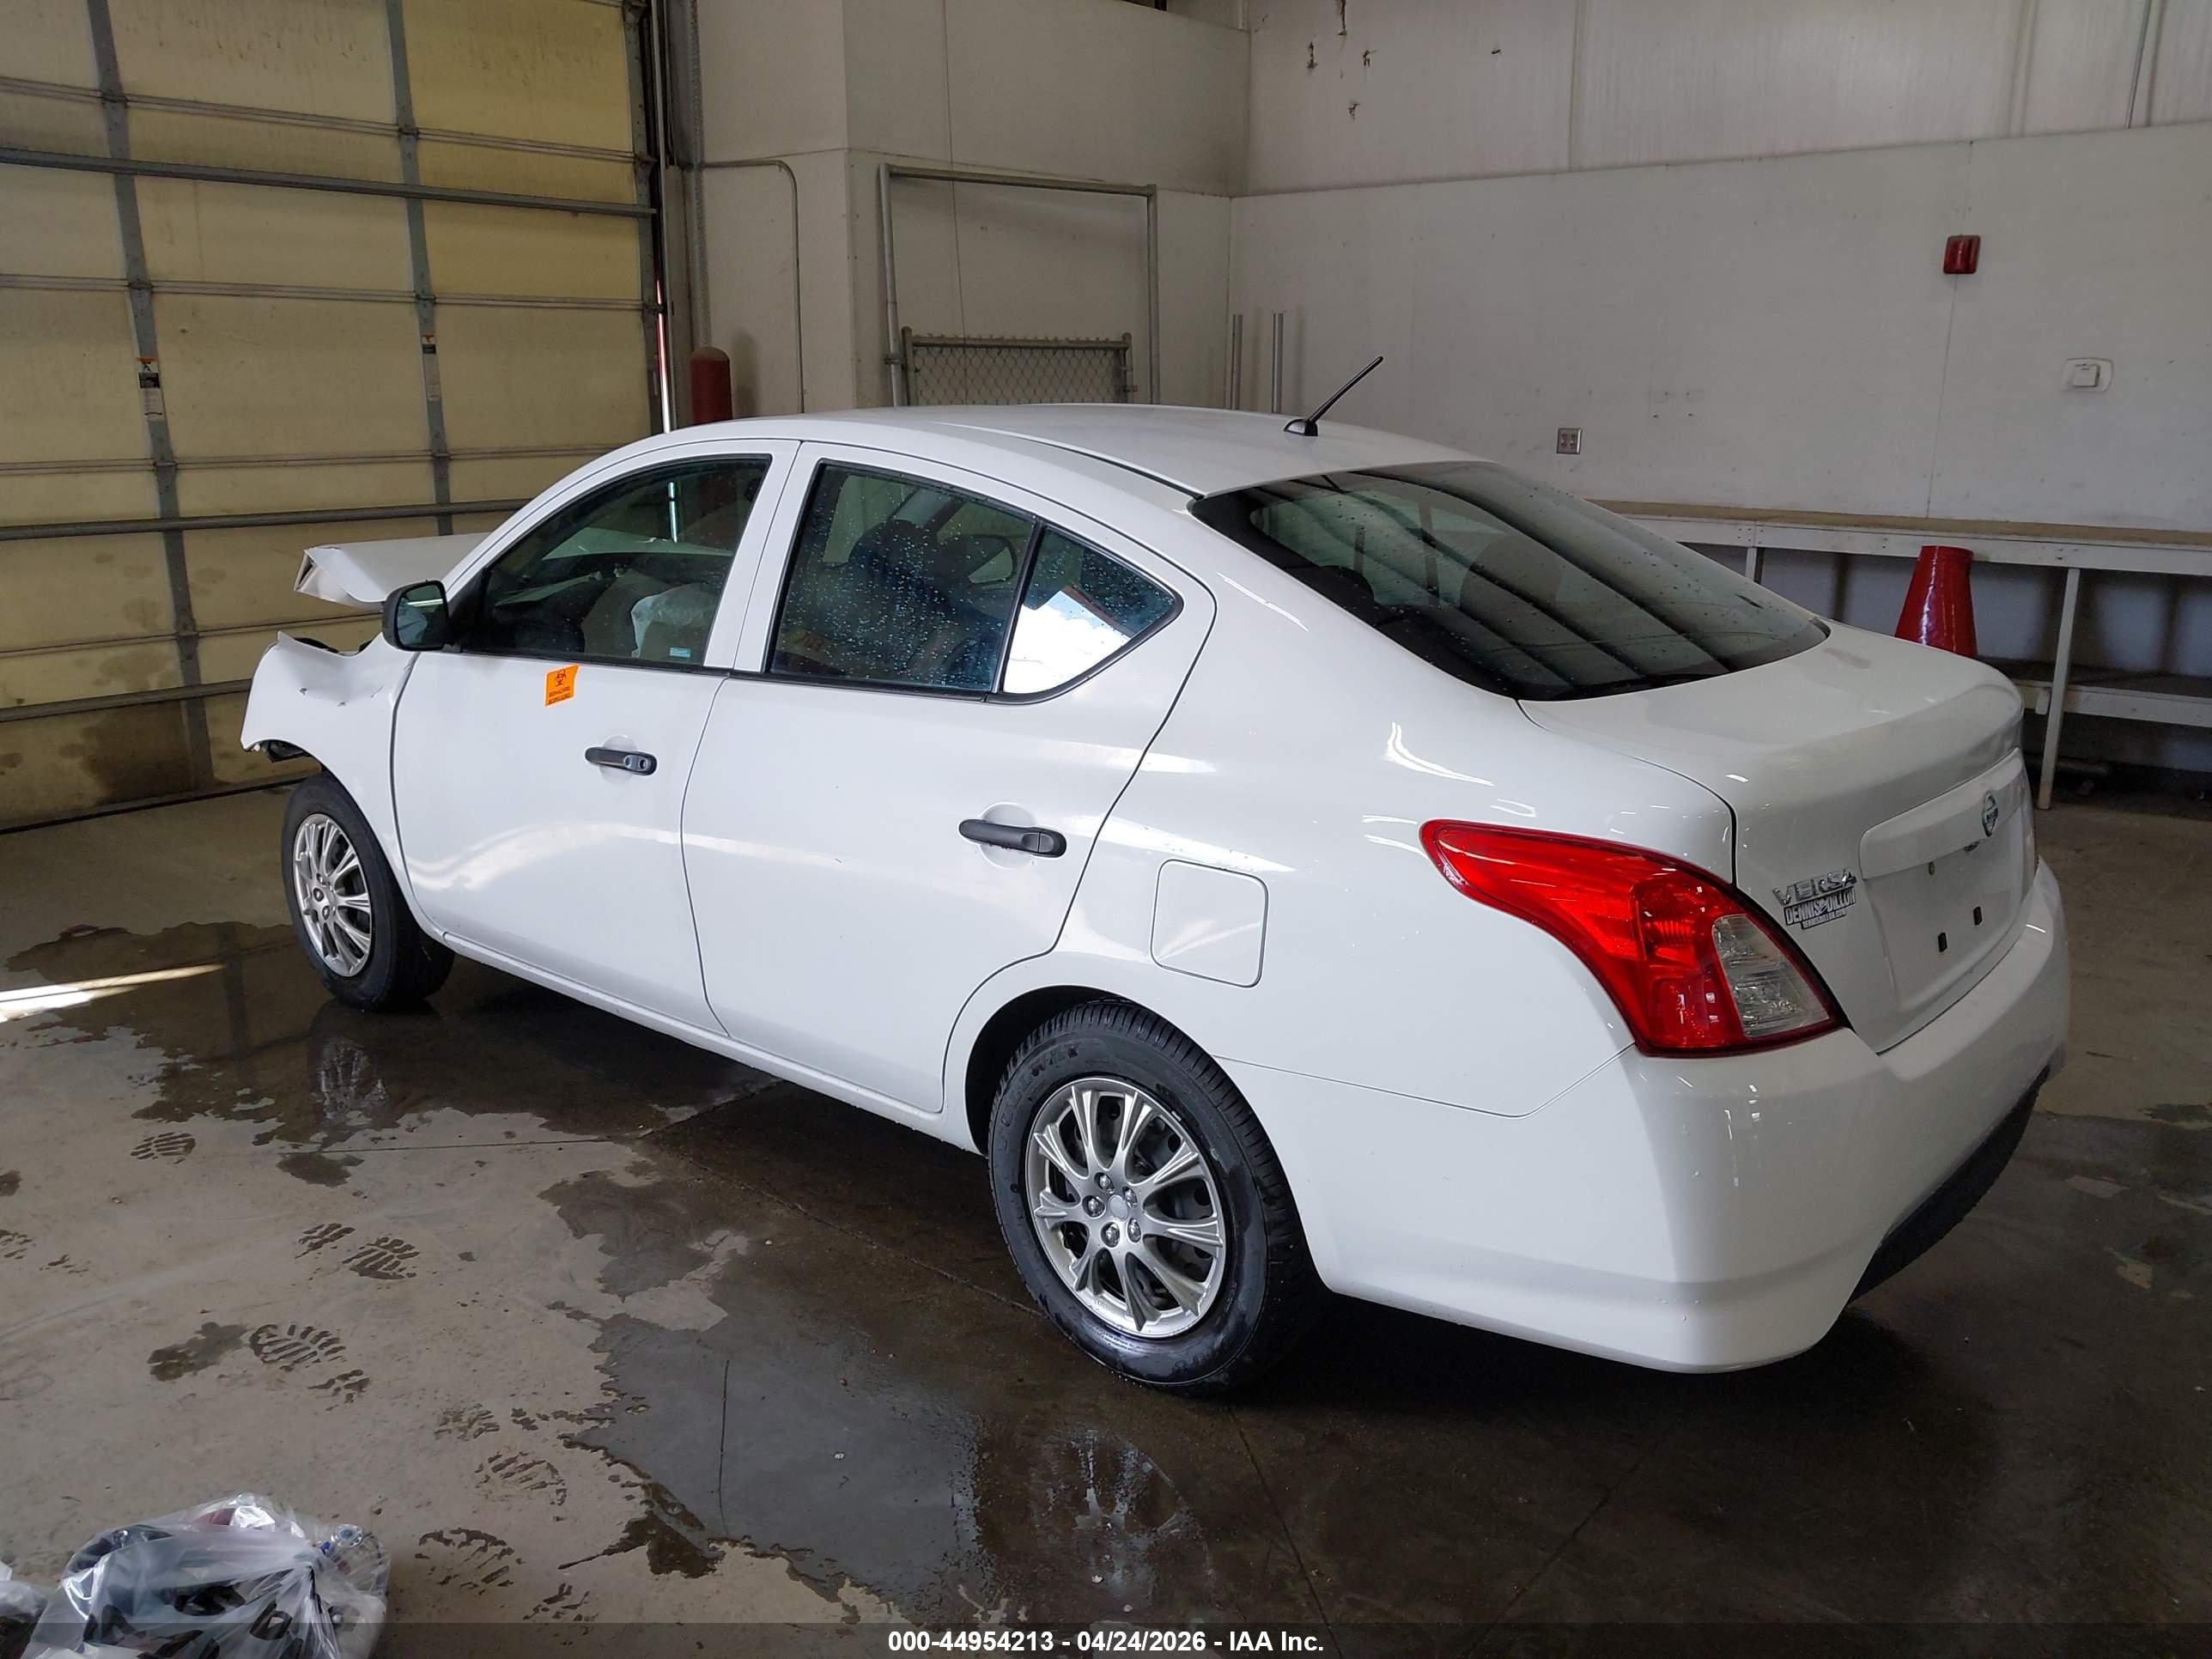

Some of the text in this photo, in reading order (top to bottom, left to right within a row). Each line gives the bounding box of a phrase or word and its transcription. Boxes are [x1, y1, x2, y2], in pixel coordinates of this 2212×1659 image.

[1772, 868, 1857, 906] VERSA
[1785, 899, 1823, 925] DENNIS
[1826, 887, 1856, 913] DILLON
